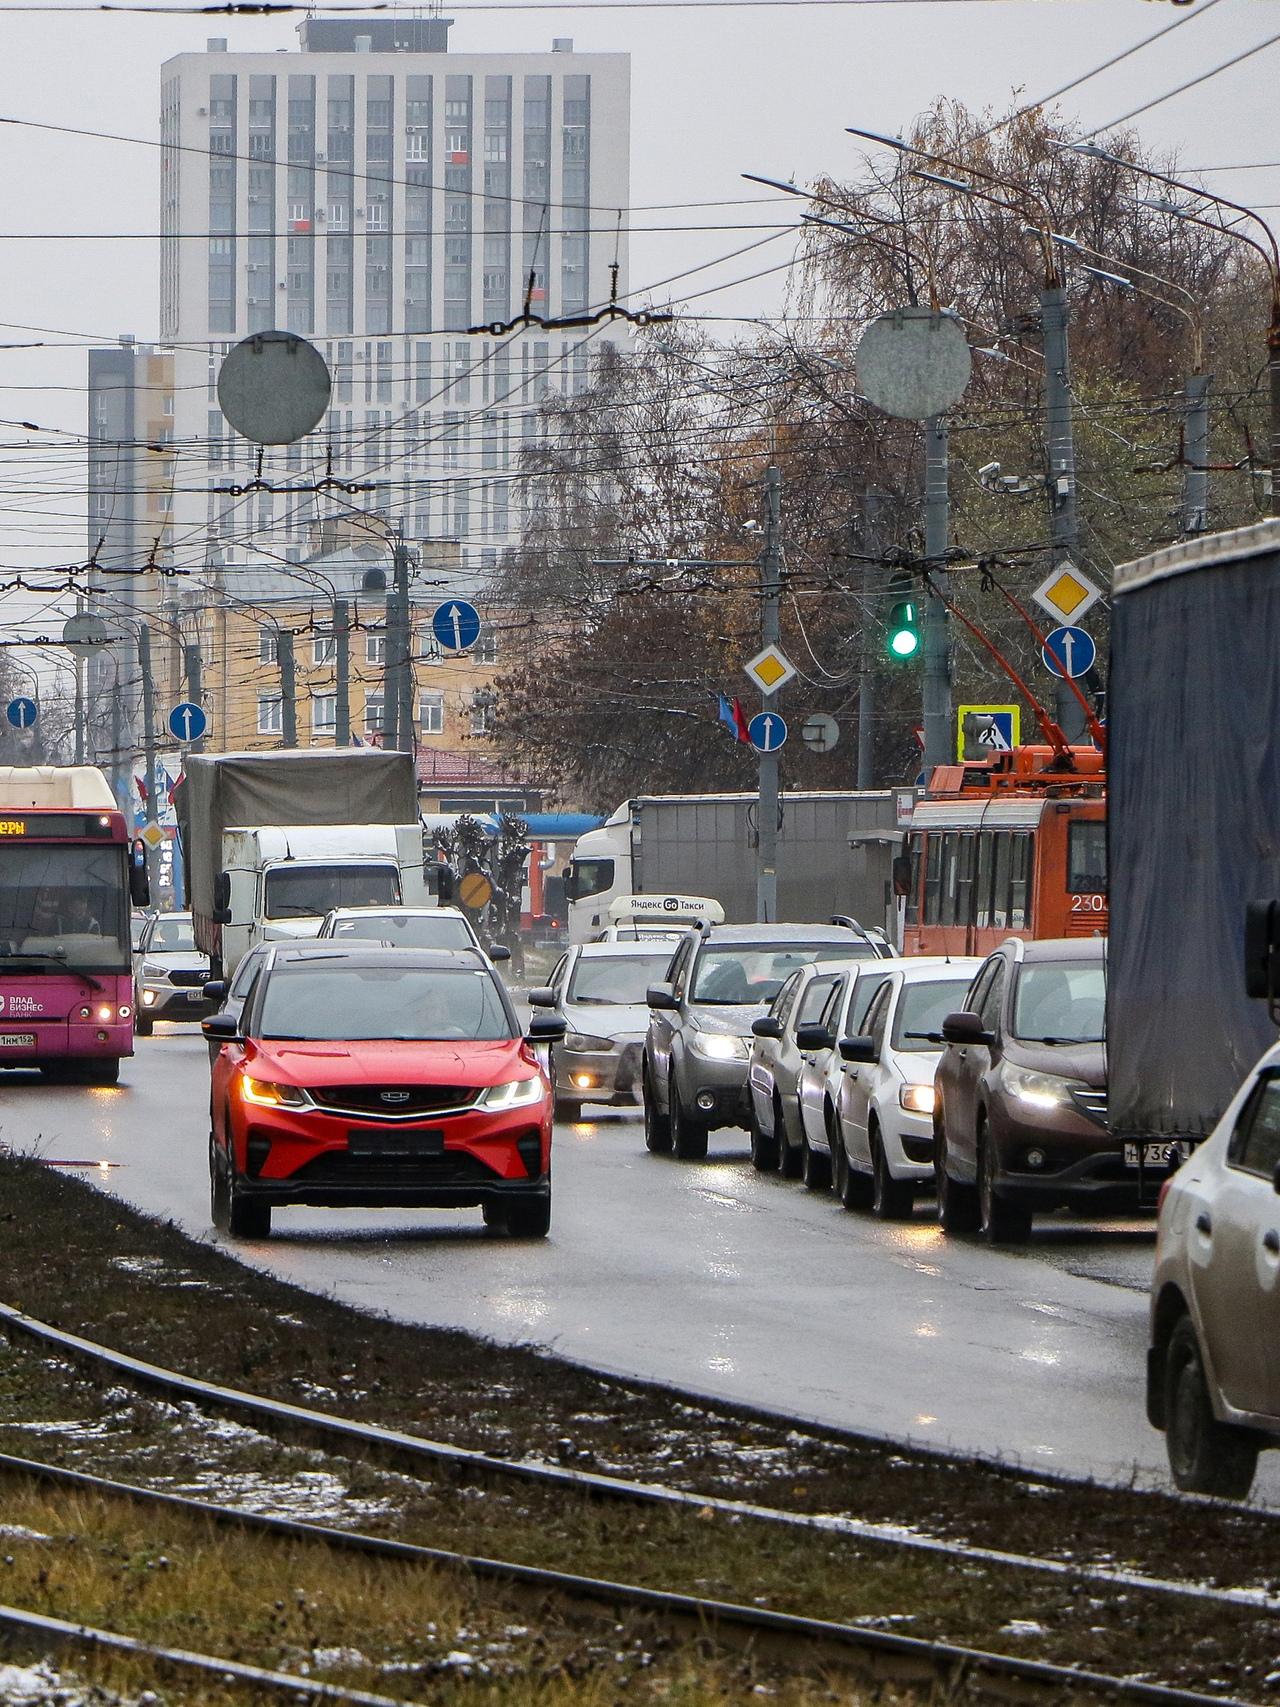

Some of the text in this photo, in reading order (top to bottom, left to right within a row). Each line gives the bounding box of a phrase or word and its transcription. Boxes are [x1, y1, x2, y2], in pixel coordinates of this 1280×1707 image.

[631, 900, 704, 910] Яндекс Go Такси
[9, 996, 33, 1004] ВЛАД
[9, 1003, 44, 1011] БИЗНЕС
